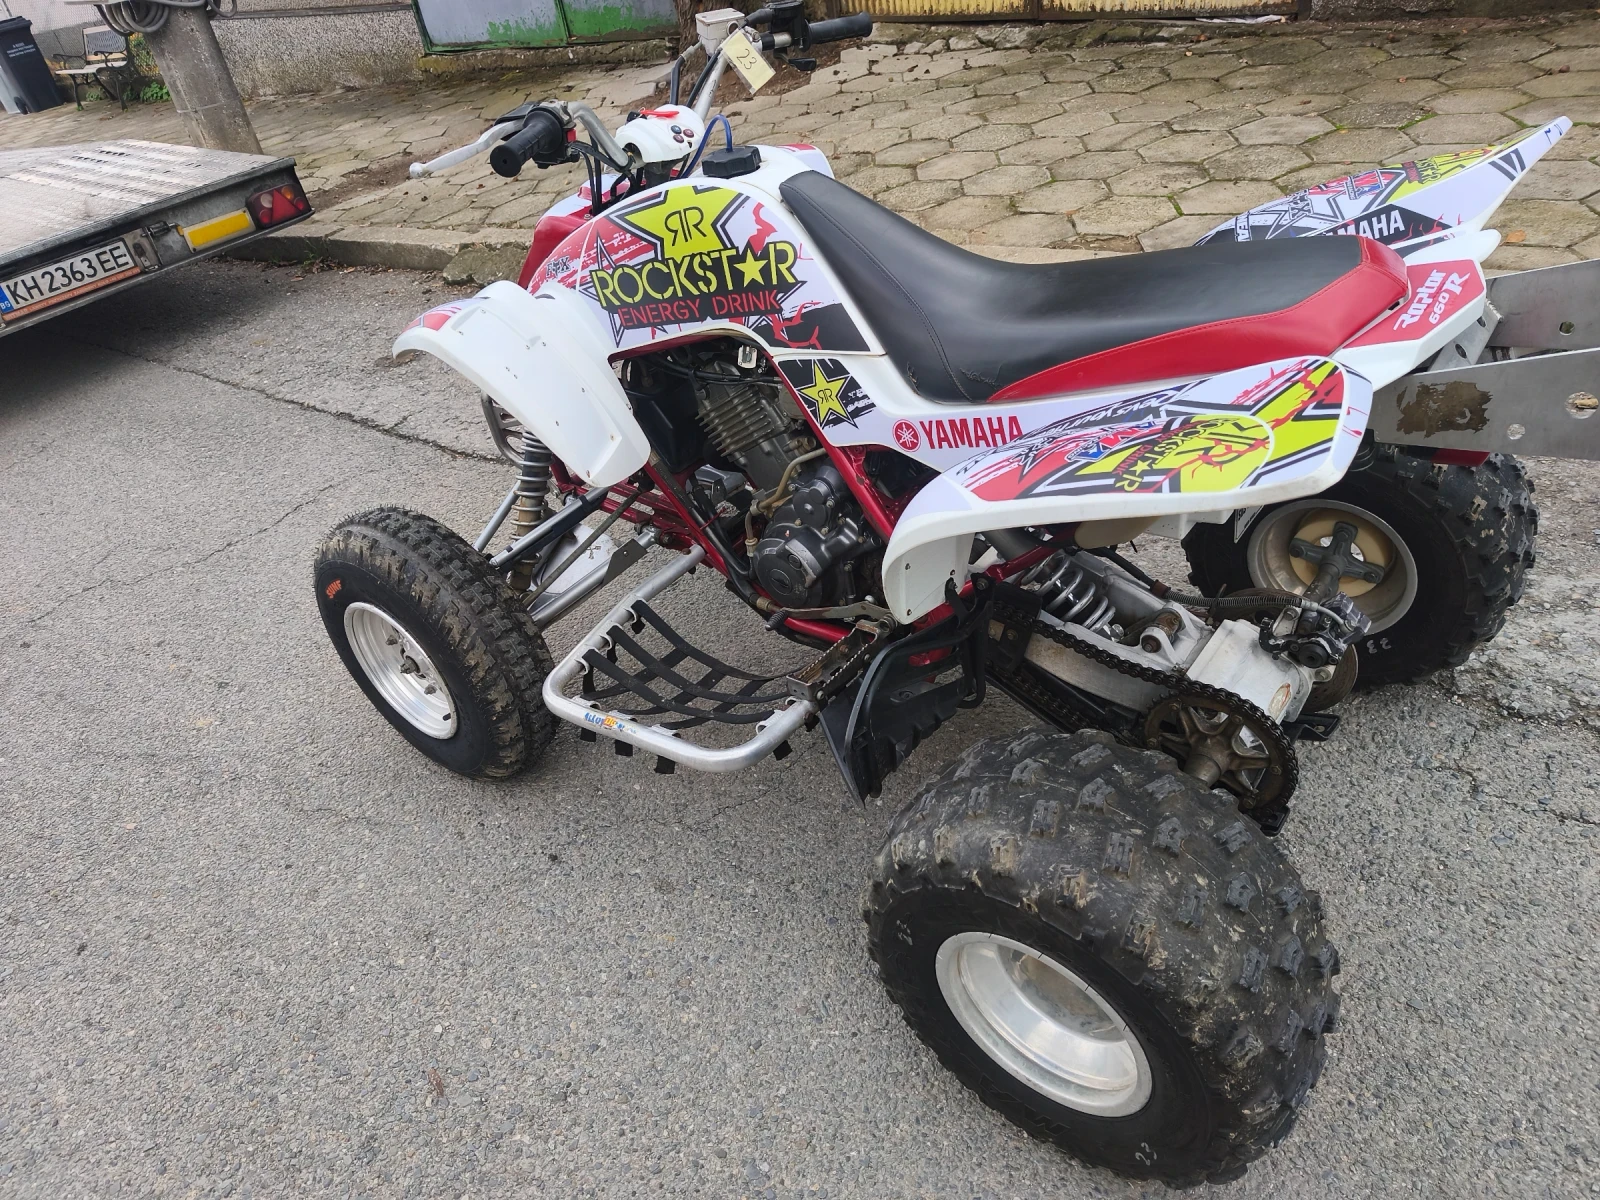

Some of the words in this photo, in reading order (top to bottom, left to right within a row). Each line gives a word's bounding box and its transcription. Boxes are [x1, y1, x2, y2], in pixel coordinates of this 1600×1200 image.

[736, 48, 757, 70] 23
[1324, 210, 1405, 239] MAHA
[6, 275, 44, 305] KH
[41, 257, 98, 293] 2363
[96, 245, 130, 273] EE
[1, 301, 11, 310] BG
[618, 299, 701, 327] ENERGY
[712, 290, 781, 316] DRINK
[1428, 272, 1471, 325] 660R
[920, 415, 1025, 449] YAMAHA
[1112, 444, 1153, 476] DRINK
